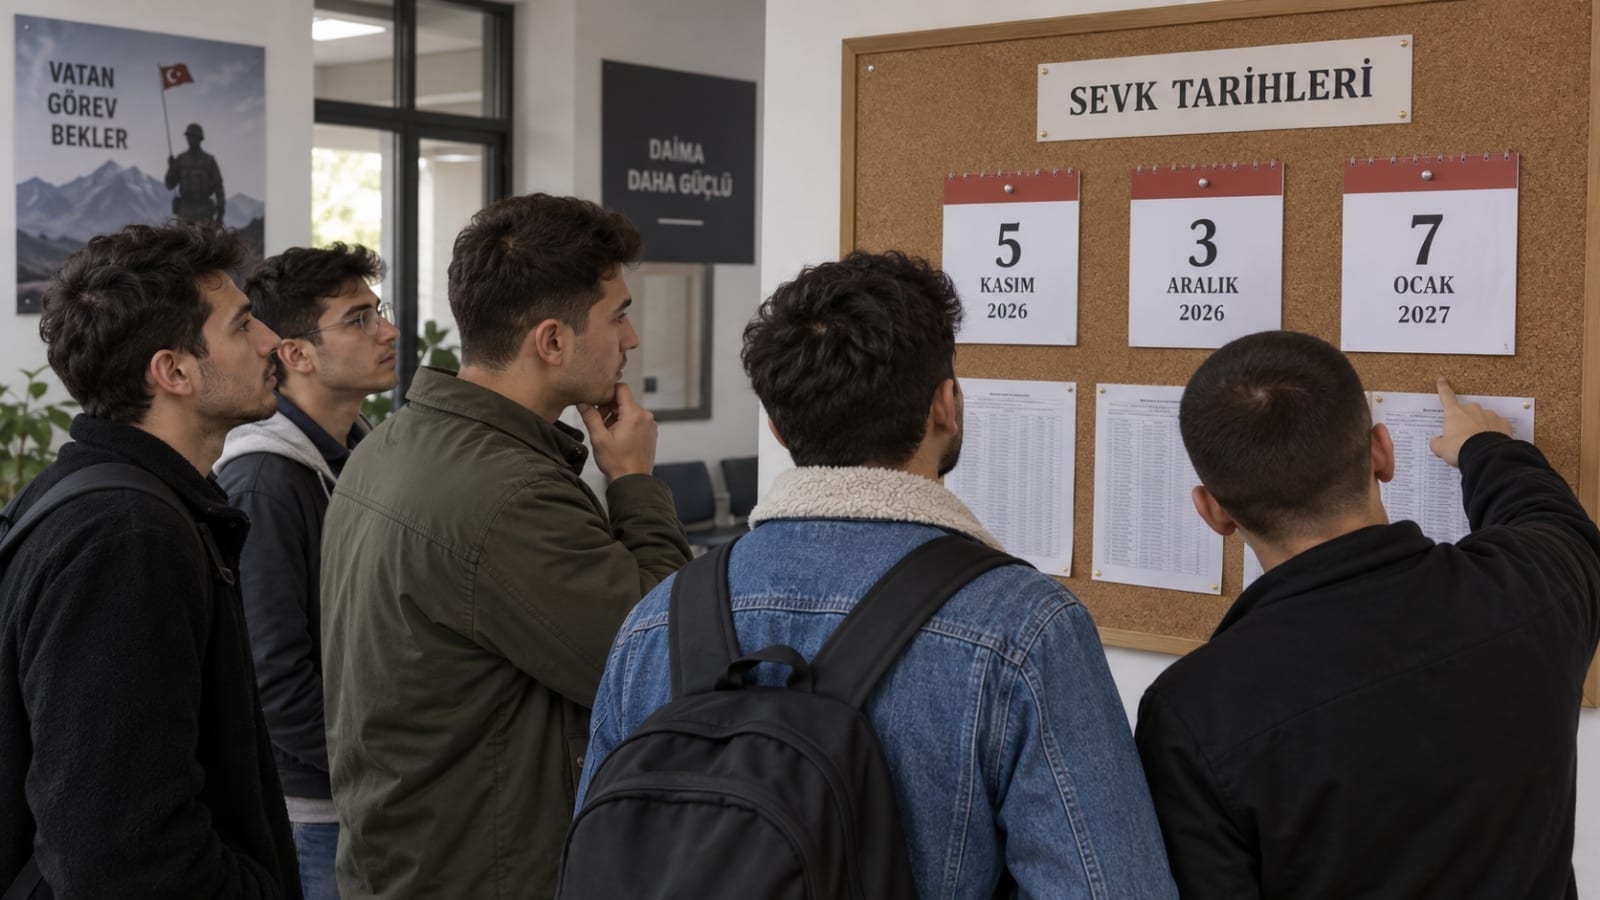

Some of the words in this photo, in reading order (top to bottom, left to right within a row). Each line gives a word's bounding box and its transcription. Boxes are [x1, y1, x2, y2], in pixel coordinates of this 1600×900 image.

[49, 61, 115, 89] VATAN
[1069, 81, 1158, 116] SEVK
[1172, 58, 1374, 109] TARİHLERİ
[48, 89, 118, 119] GÖREV
[52, 123, 128, 150] BEKLER
[649, 136, 705, 164] DAİMA
[627, 169, 677, 193] DAHA
[679, 169, 733, 201] GÜÇLÜ
[995, 222, 1022, 268] 5
[1188, 218, 1218, 268] 3
[1411, 213, 1444, 266] 7
[980, 276, 1035, 294] KASIM
[1166, 276, 1239, 294] ARALIK
[1393, 275, 1455, 295] OCAK
[987, 303, 1028, 319] 2026
[1179, 303, 1225, 321] 2026
[1398, 305, 1451, 324] 2027
